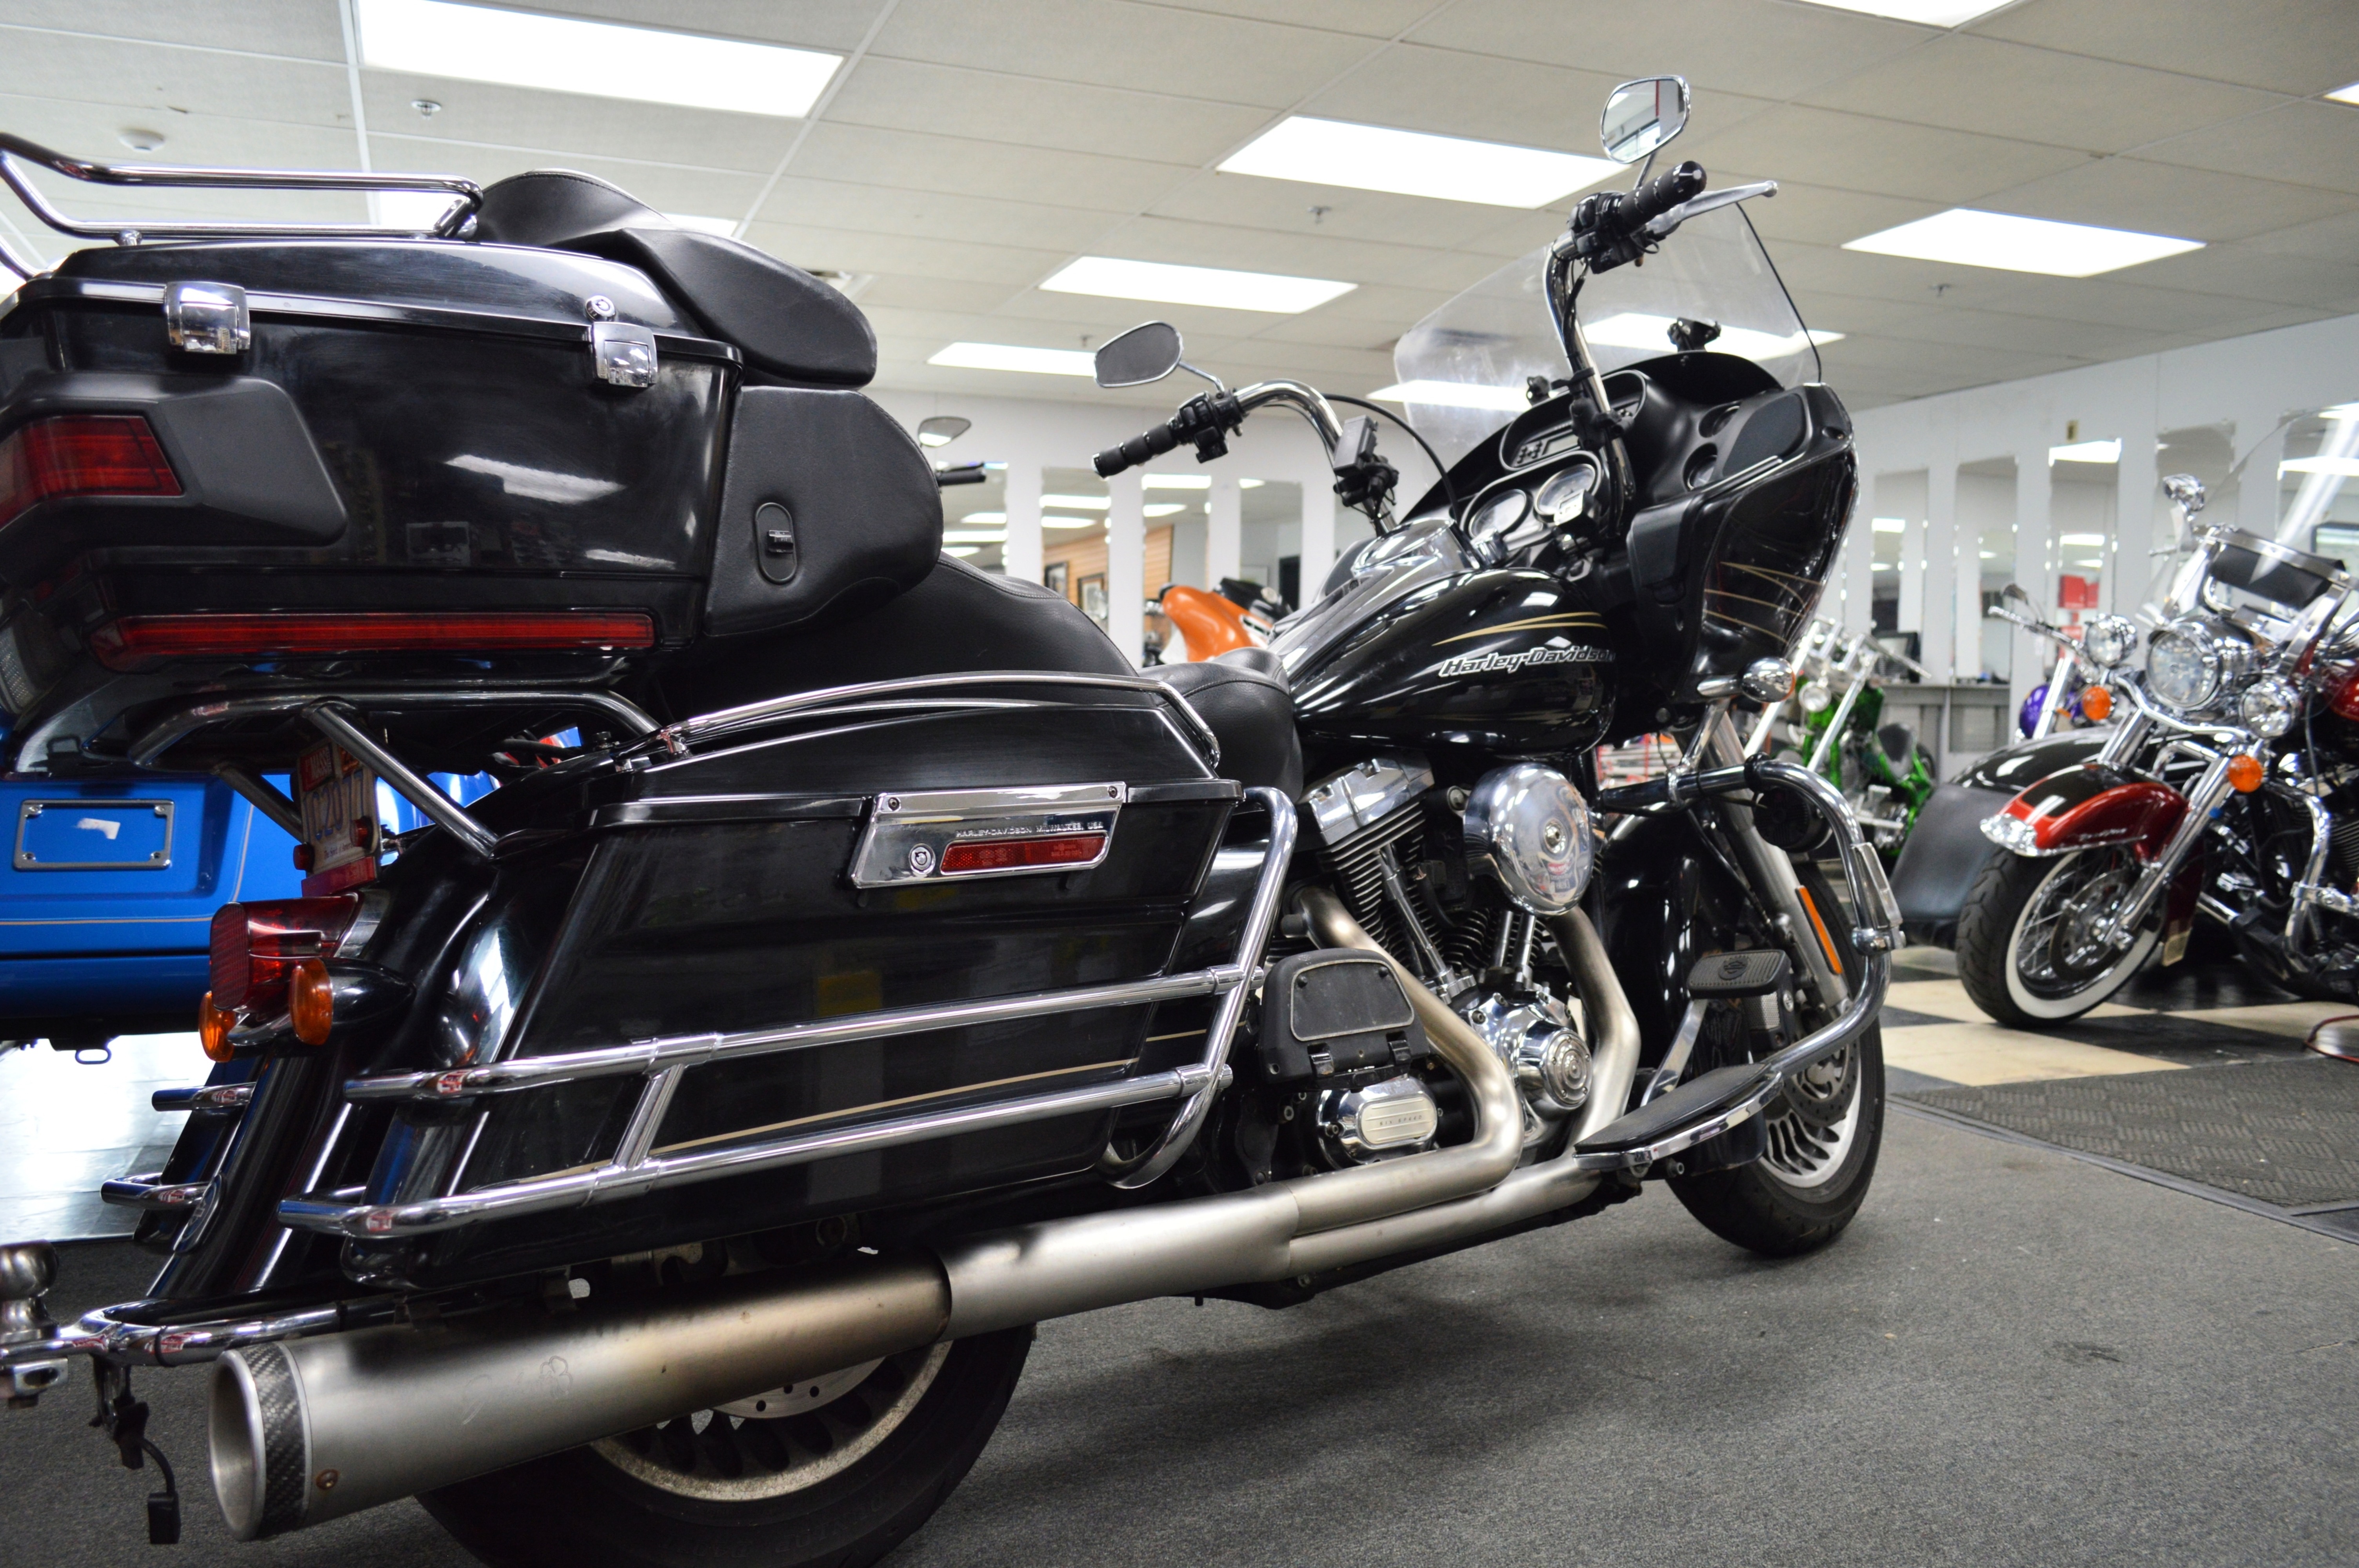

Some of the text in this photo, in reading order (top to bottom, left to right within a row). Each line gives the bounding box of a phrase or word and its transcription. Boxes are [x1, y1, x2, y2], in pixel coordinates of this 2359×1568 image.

[1438, 645, 1615, 677] Harley-Davidson
[956, 827, 1032, 838] HARLEY-DAVIDSON
[1087, 821, 1103, 829] USA
